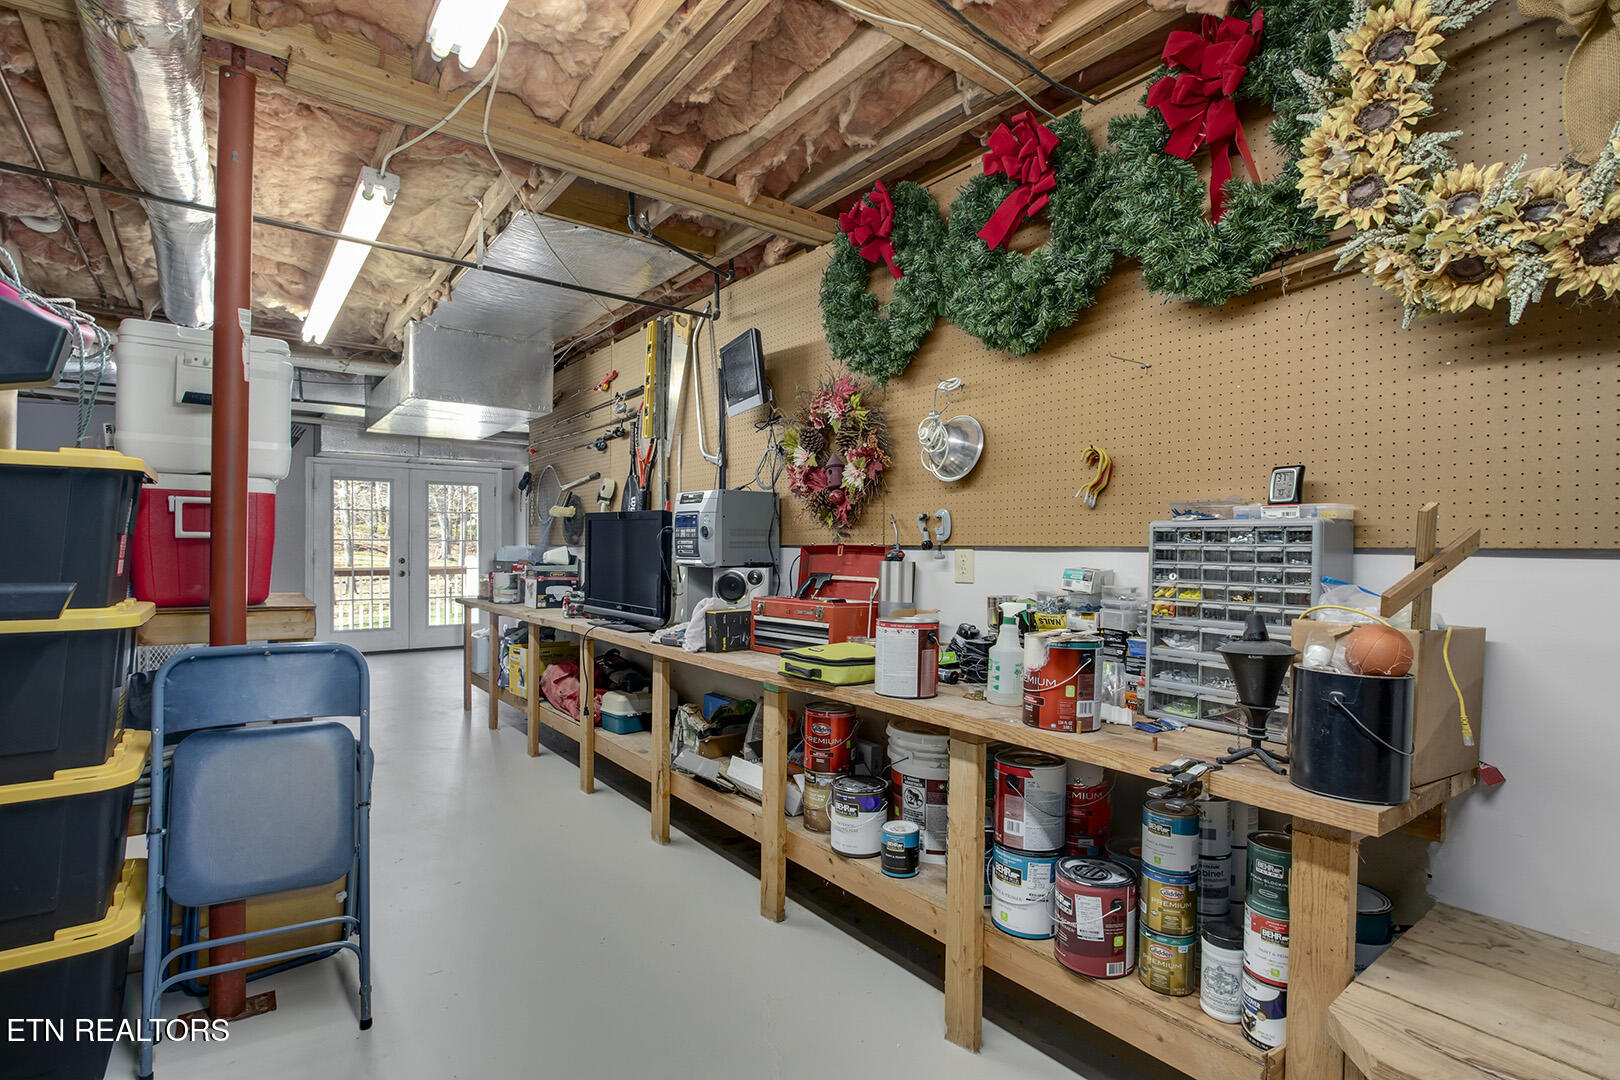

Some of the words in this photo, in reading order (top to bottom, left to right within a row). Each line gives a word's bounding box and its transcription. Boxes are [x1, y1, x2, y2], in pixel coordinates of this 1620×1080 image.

[105, 424, 113, 434] 3M
[1038, 617, 1062, 626] NAILS
[806, 736, 842, 745] PREMIUM
[1257, 861, 1274, 871] BEHR
[1160, 888, 1184, 898] Glidden
[1151, 896, 1192, 909] PREMIUM
[1262, 928, 1281, 941] BEHR
[1149, 945, 1173, 958] Glidden
[1142, 953, 1183, 969] PREMIUM
